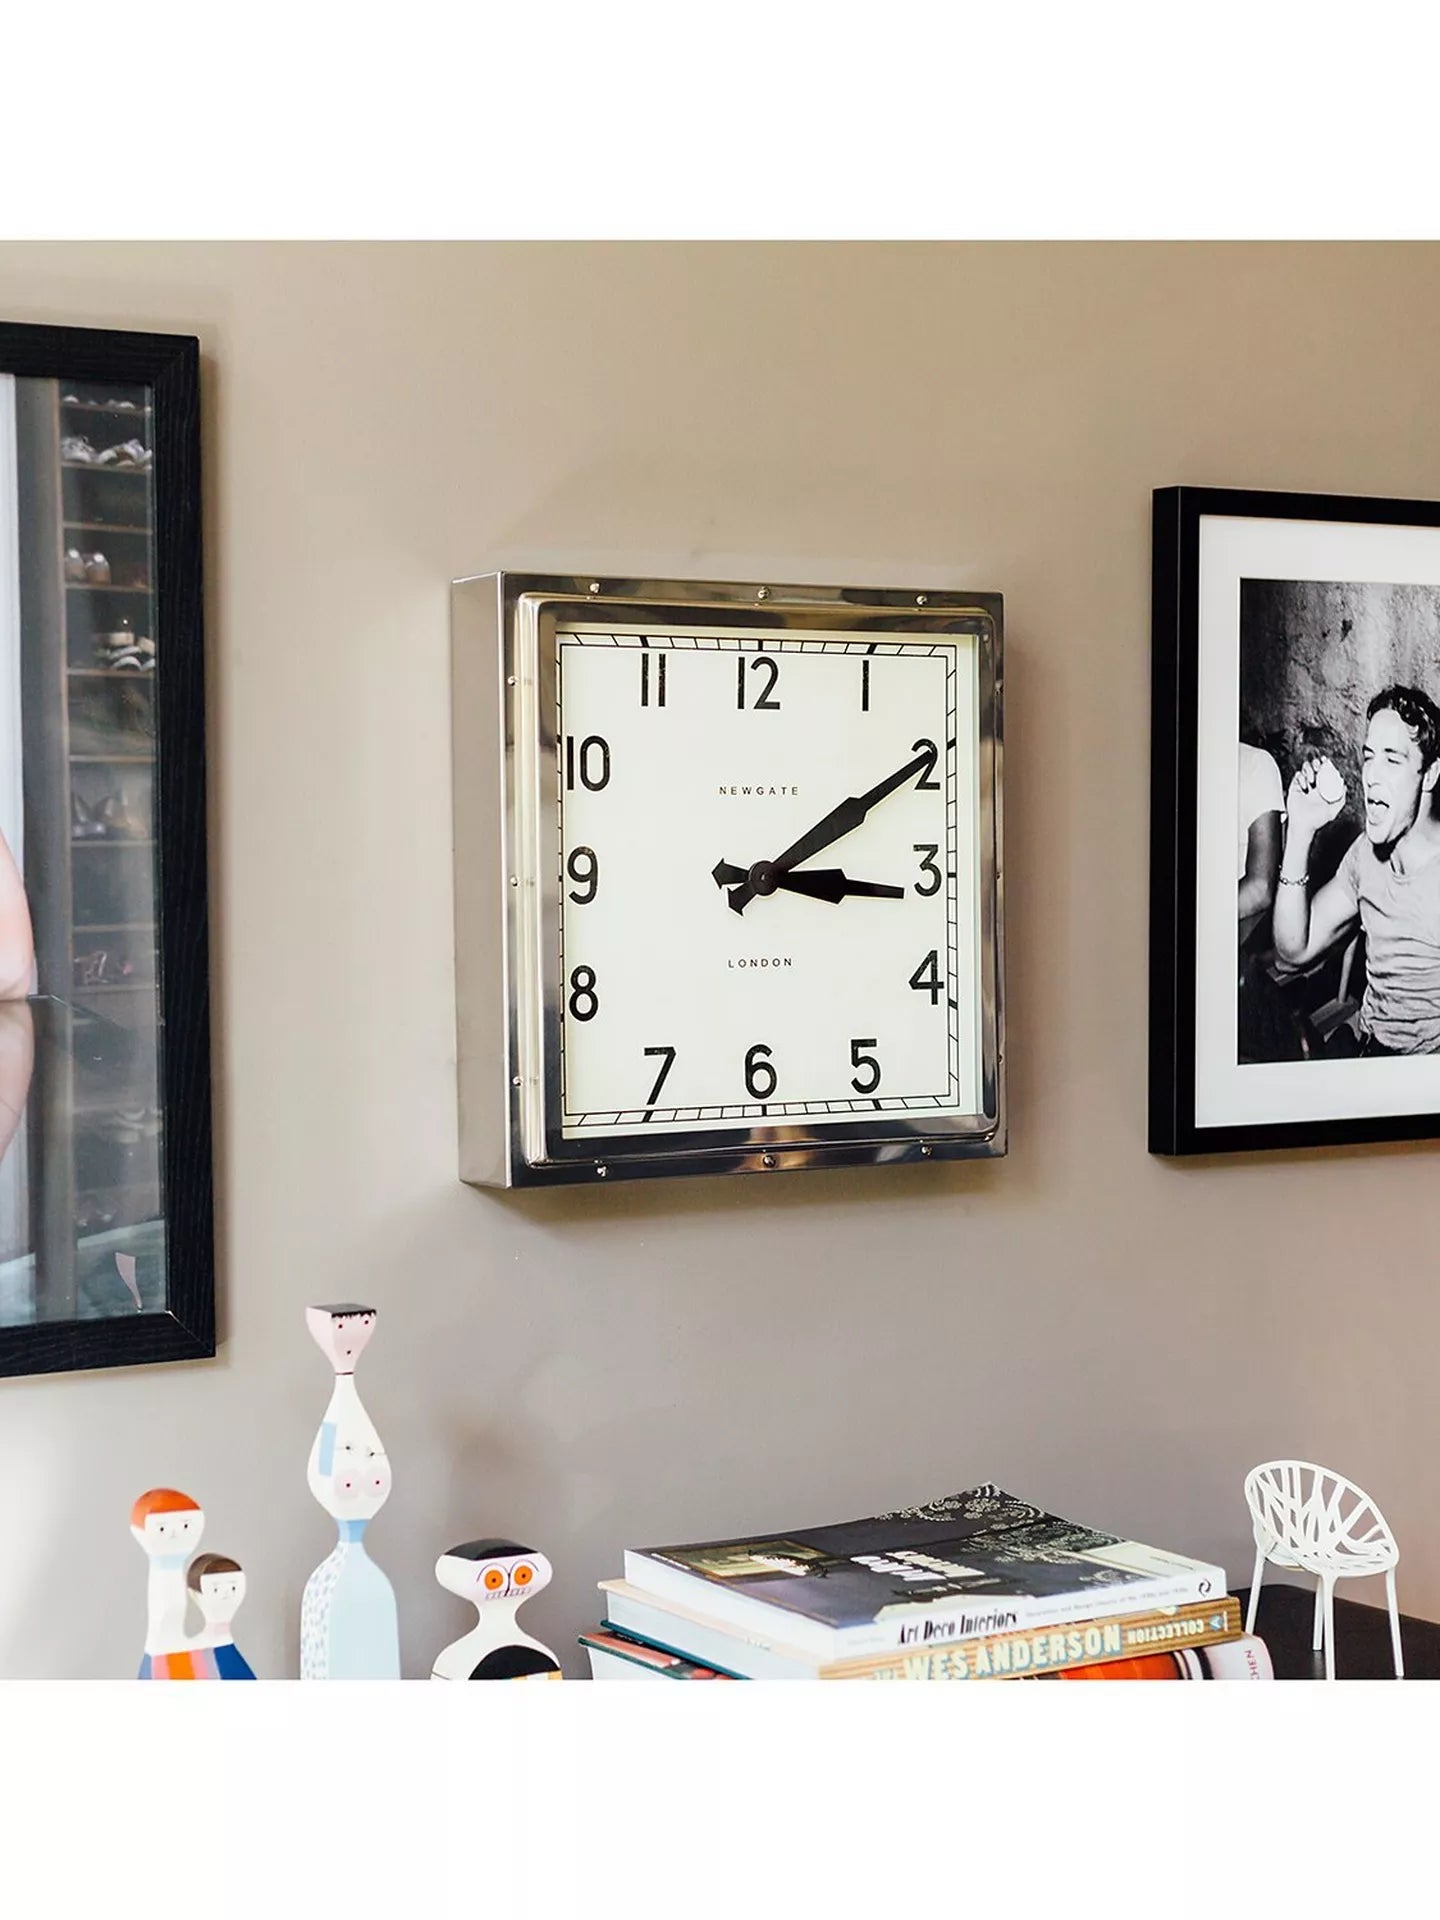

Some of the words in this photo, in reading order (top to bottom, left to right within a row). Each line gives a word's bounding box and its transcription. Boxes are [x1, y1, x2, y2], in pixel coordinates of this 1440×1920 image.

[640, 653, 667, 708] 11
[737, 656, 781, 711] 12
[861, 659, 870, 712] 1
[566, 735, 611, 792] 10
[719, 786, 799, 796] NEWGATE
[911, 738, 941, 790] 2
[566, 846, 599, 905] 9
[912, 844, 942, 897] 3
[728, 957, 793, 969] LONDON
[908, 949, 945, 1006] 4
[568, 965, 599, 1022] 8
[643, 1046, 677, 1106] 7
[744, 1043, 777, 1100] 6
[851, 1038, 881, 1094] 5
[899, 1624, 919, 1644] Art
[923, 1620, 956, 1641] Deco
[960, 1608, 1017, 1635] Interiors
[903, 1649, 970, 1680] WES
[975, 1623, 1121, 1676] ANDERSON
